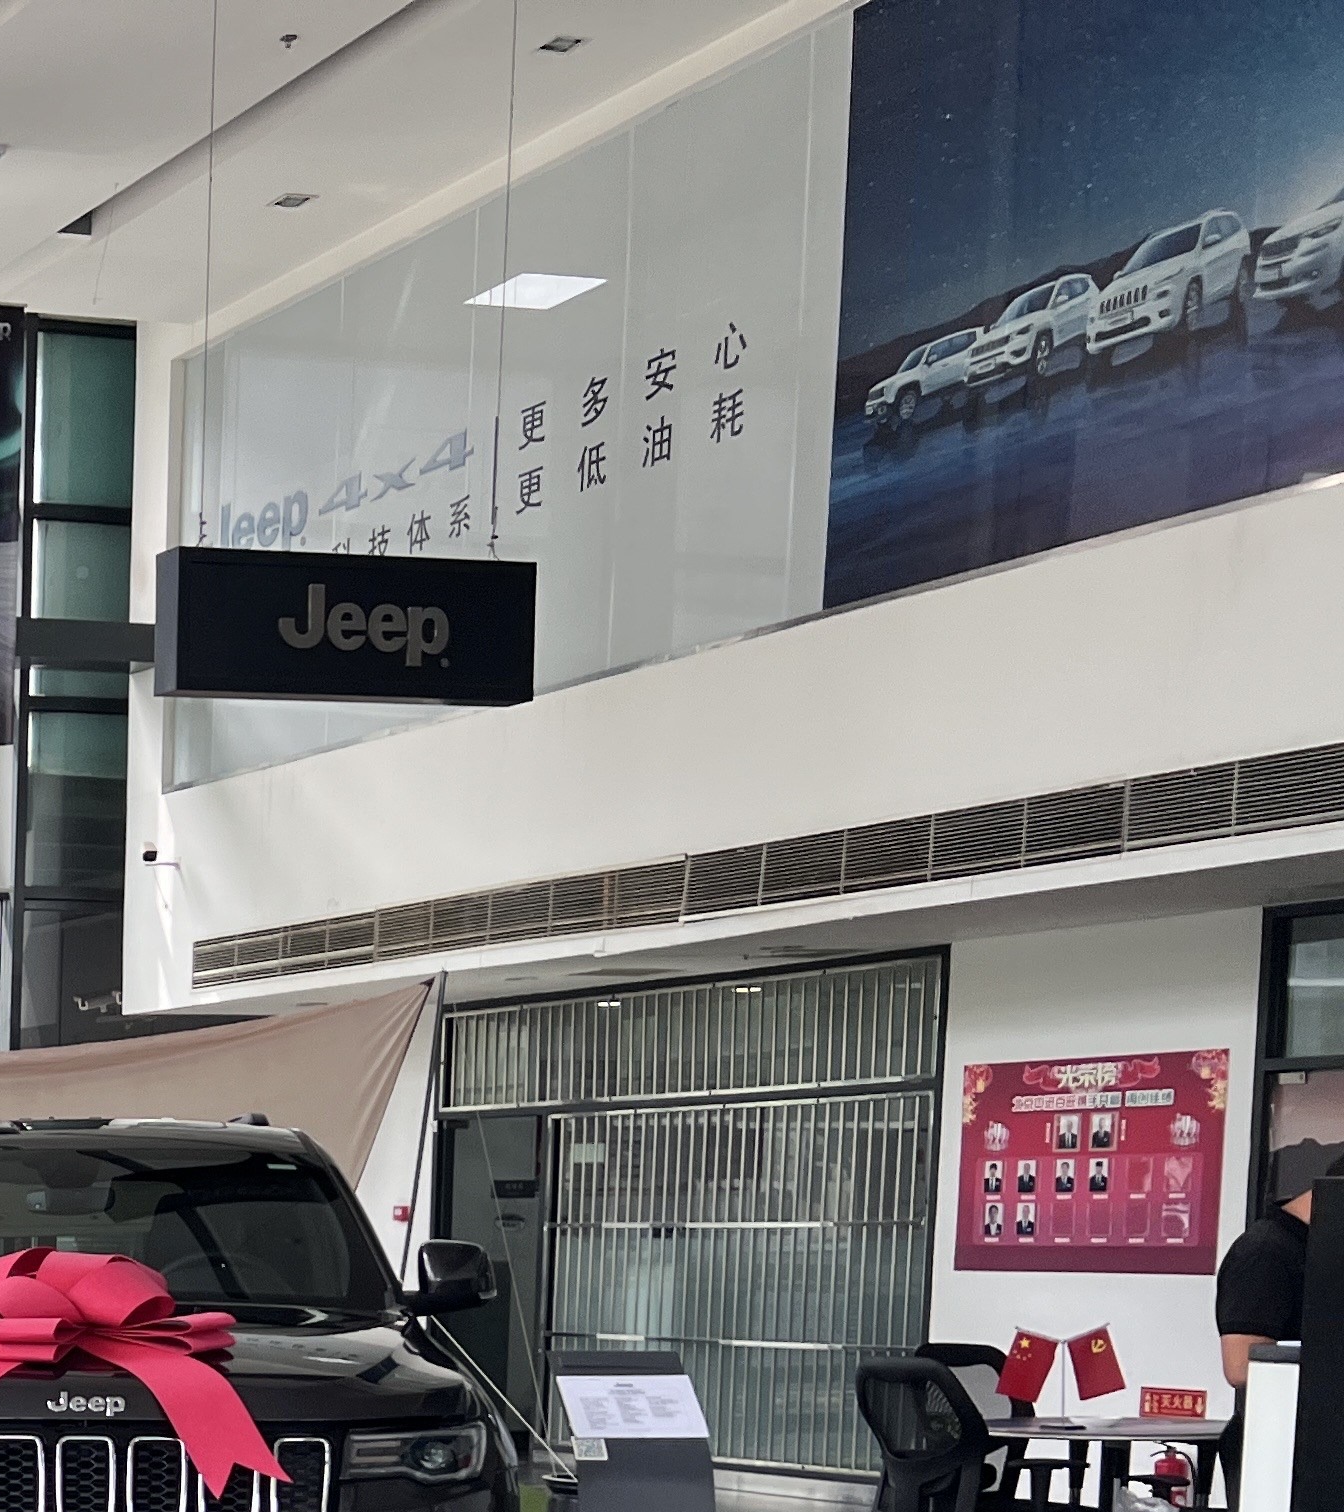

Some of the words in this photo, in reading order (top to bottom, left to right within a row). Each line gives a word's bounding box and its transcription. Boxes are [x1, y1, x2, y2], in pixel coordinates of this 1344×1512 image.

[519, 322, 747, 450] 更多安心
[516, 388, 744, 515] 更低油耗
[278, 583, 450, 667] Jeep
[46, 1391, 126, 1416] Jeep
